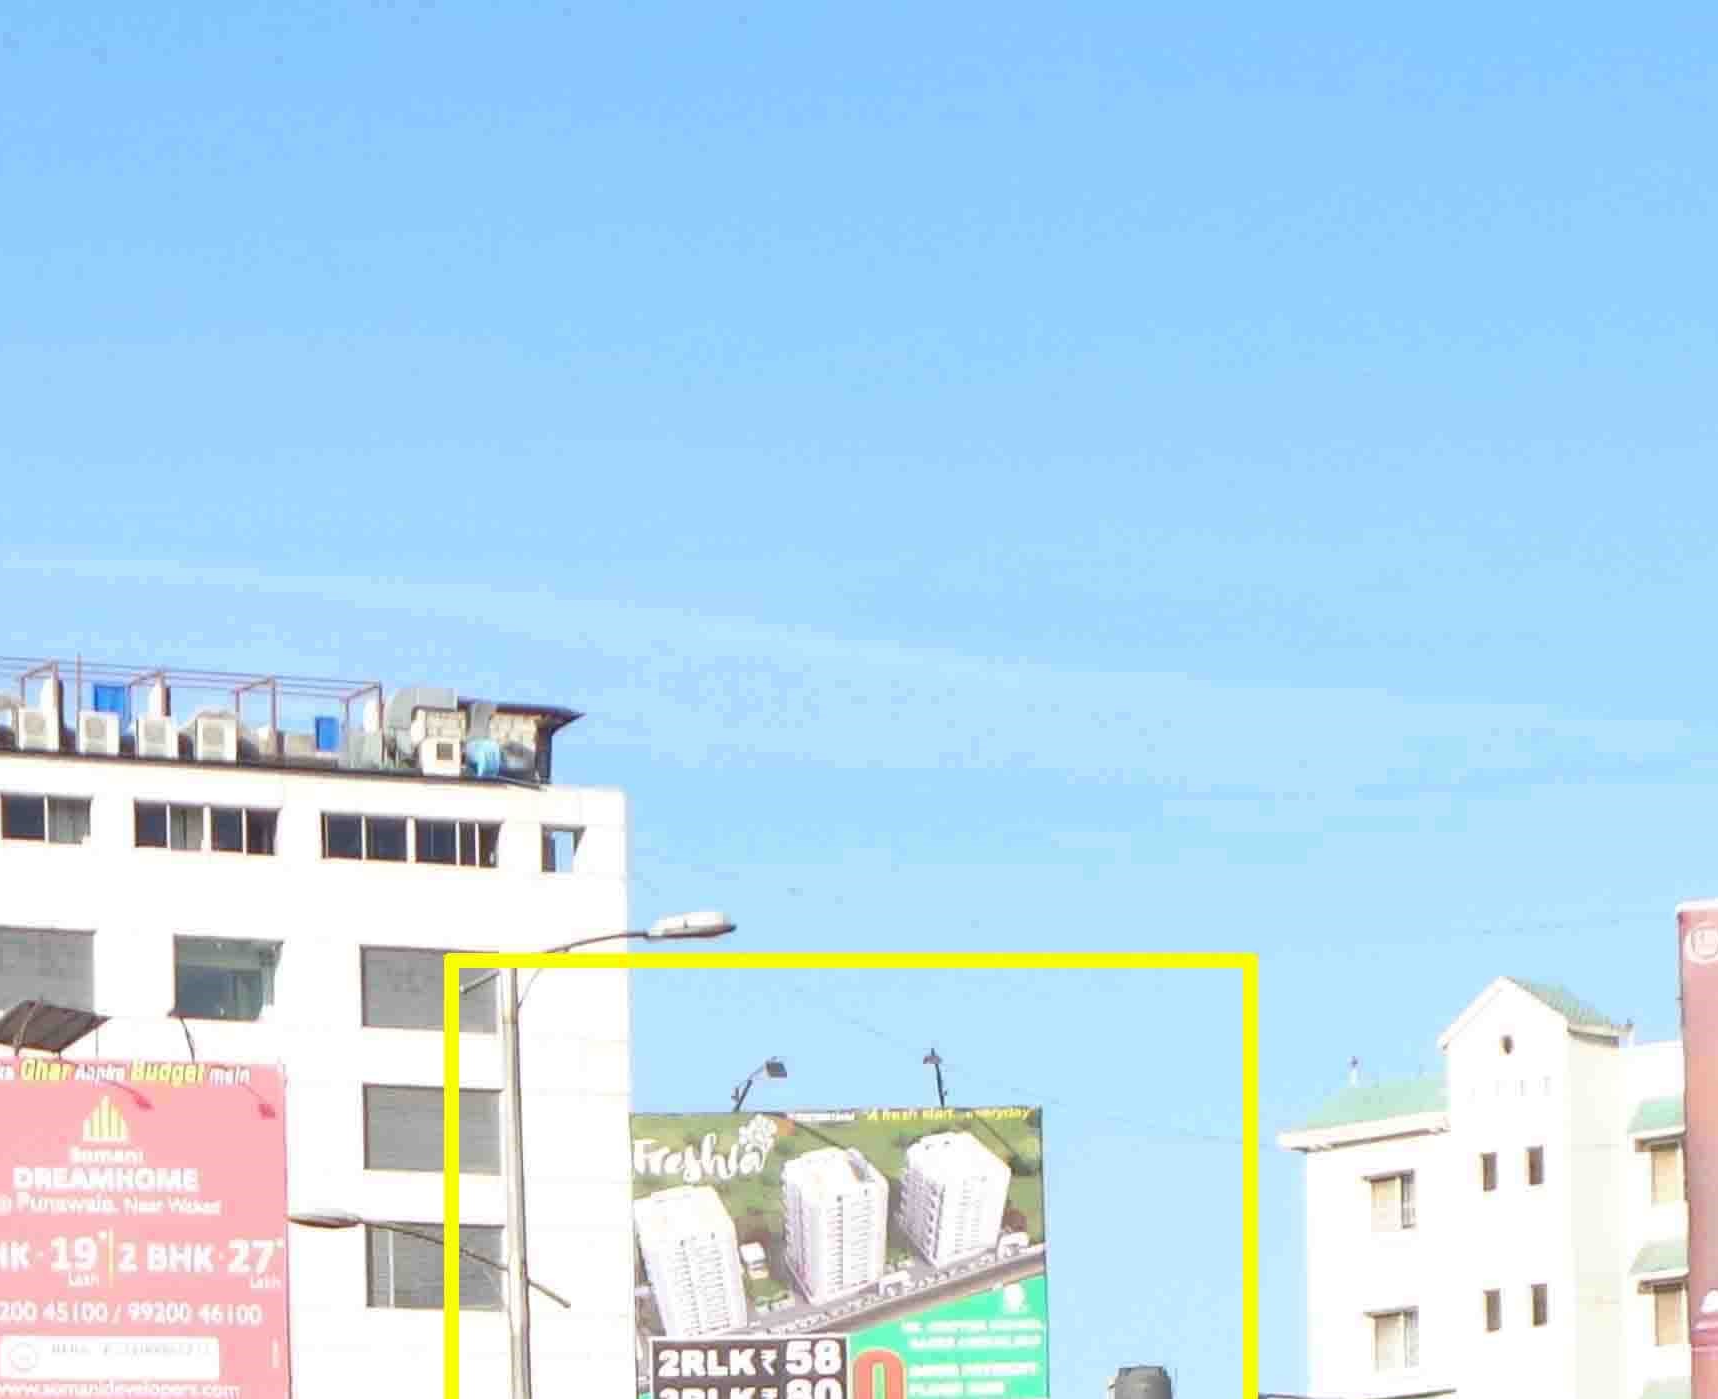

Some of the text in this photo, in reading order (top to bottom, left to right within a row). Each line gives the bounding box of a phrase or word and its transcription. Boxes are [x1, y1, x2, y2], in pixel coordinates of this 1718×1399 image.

[20, 1058, 73, 1082] Ghar
[130, 1059, 205, 1086] Budget
[13, 1167, 199, 1192] DREAMHOME
[119, 1243, 137, 1272] 2
[147, 1243, 215, 1273] BHK
[658, 1349, 757, 1377] 2RLK
